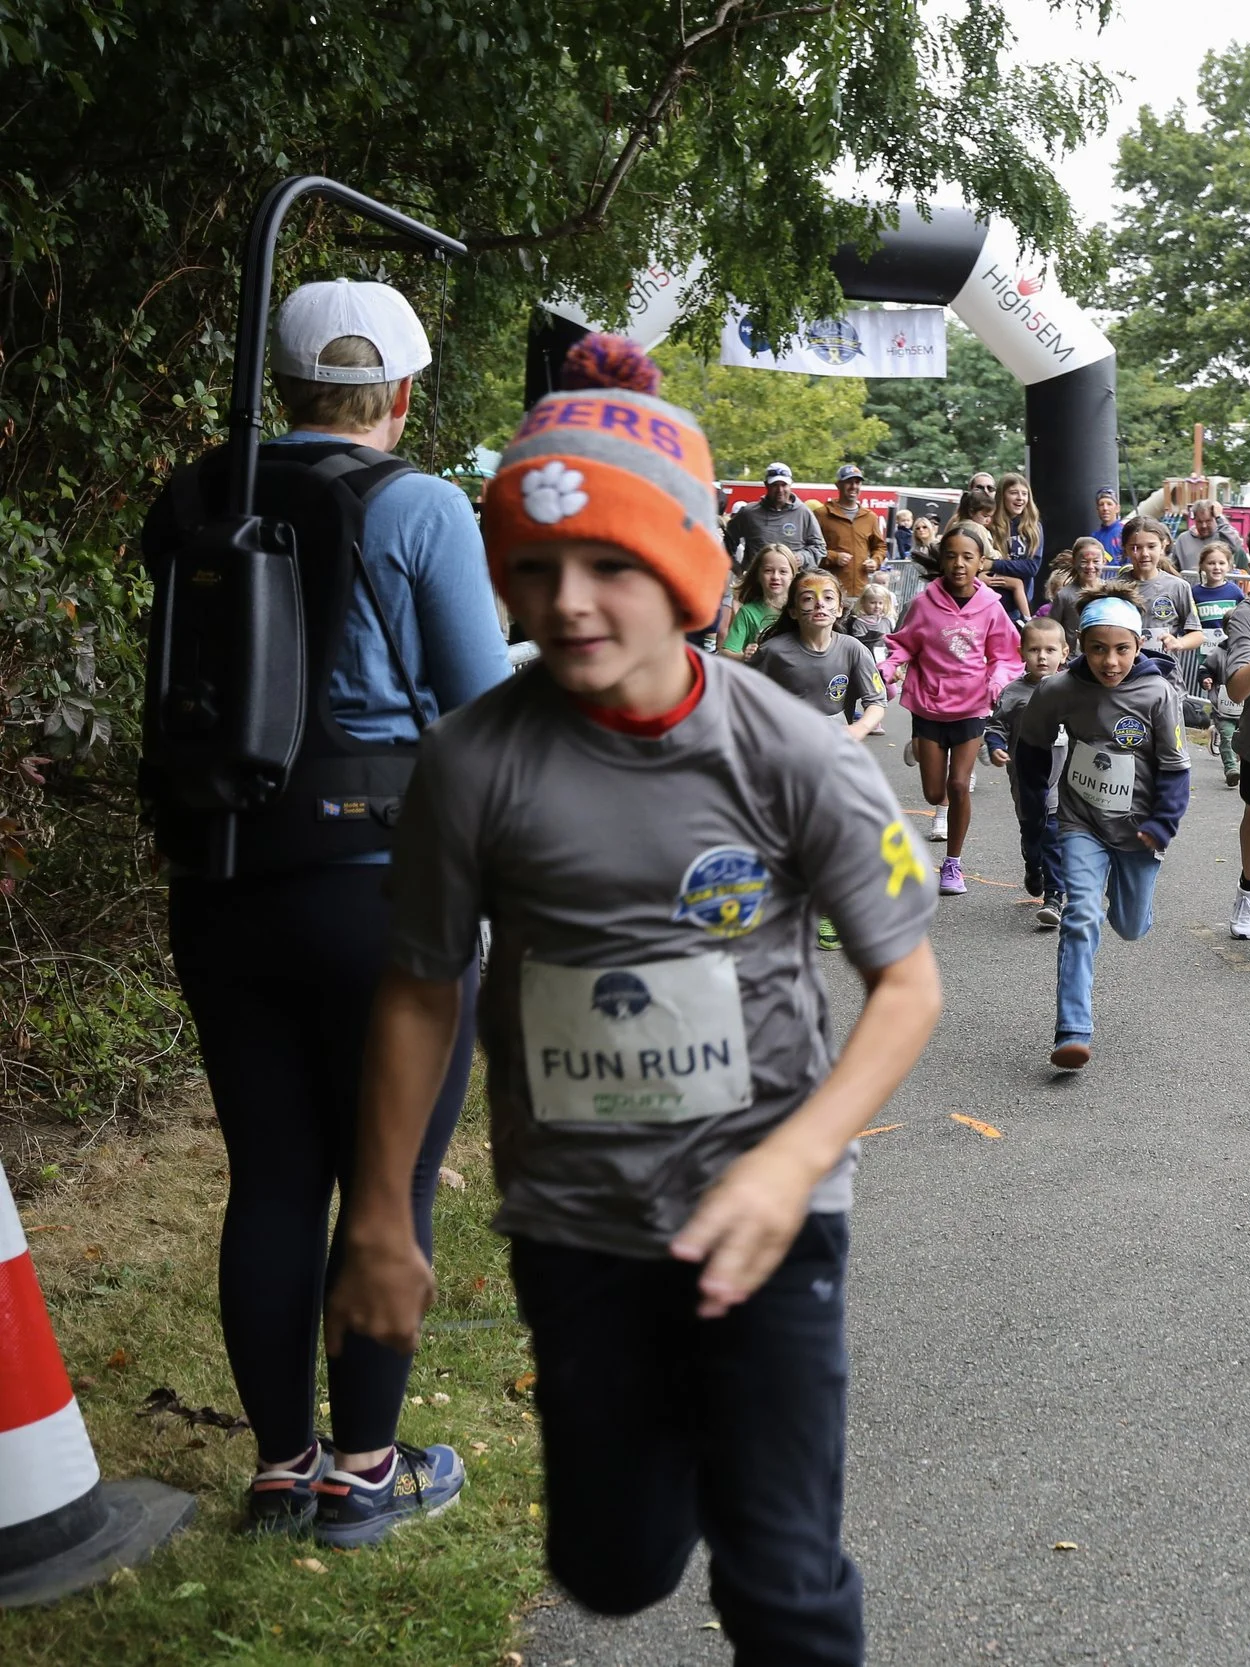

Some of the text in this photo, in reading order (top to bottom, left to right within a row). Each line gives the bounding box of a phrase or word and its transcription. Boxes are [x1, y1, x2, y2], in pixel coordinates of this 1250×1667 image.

[981, 263, 1076, 363] High5EM
[886, 345, 934, 357] High5EM
[518, 401, 684, 460] GERS
[1197, 603, 1236, 618] Wilso
[1071, 771, 1130, 796] FUN RUN
[541, 1038, 731, 1081] FUN RUN
